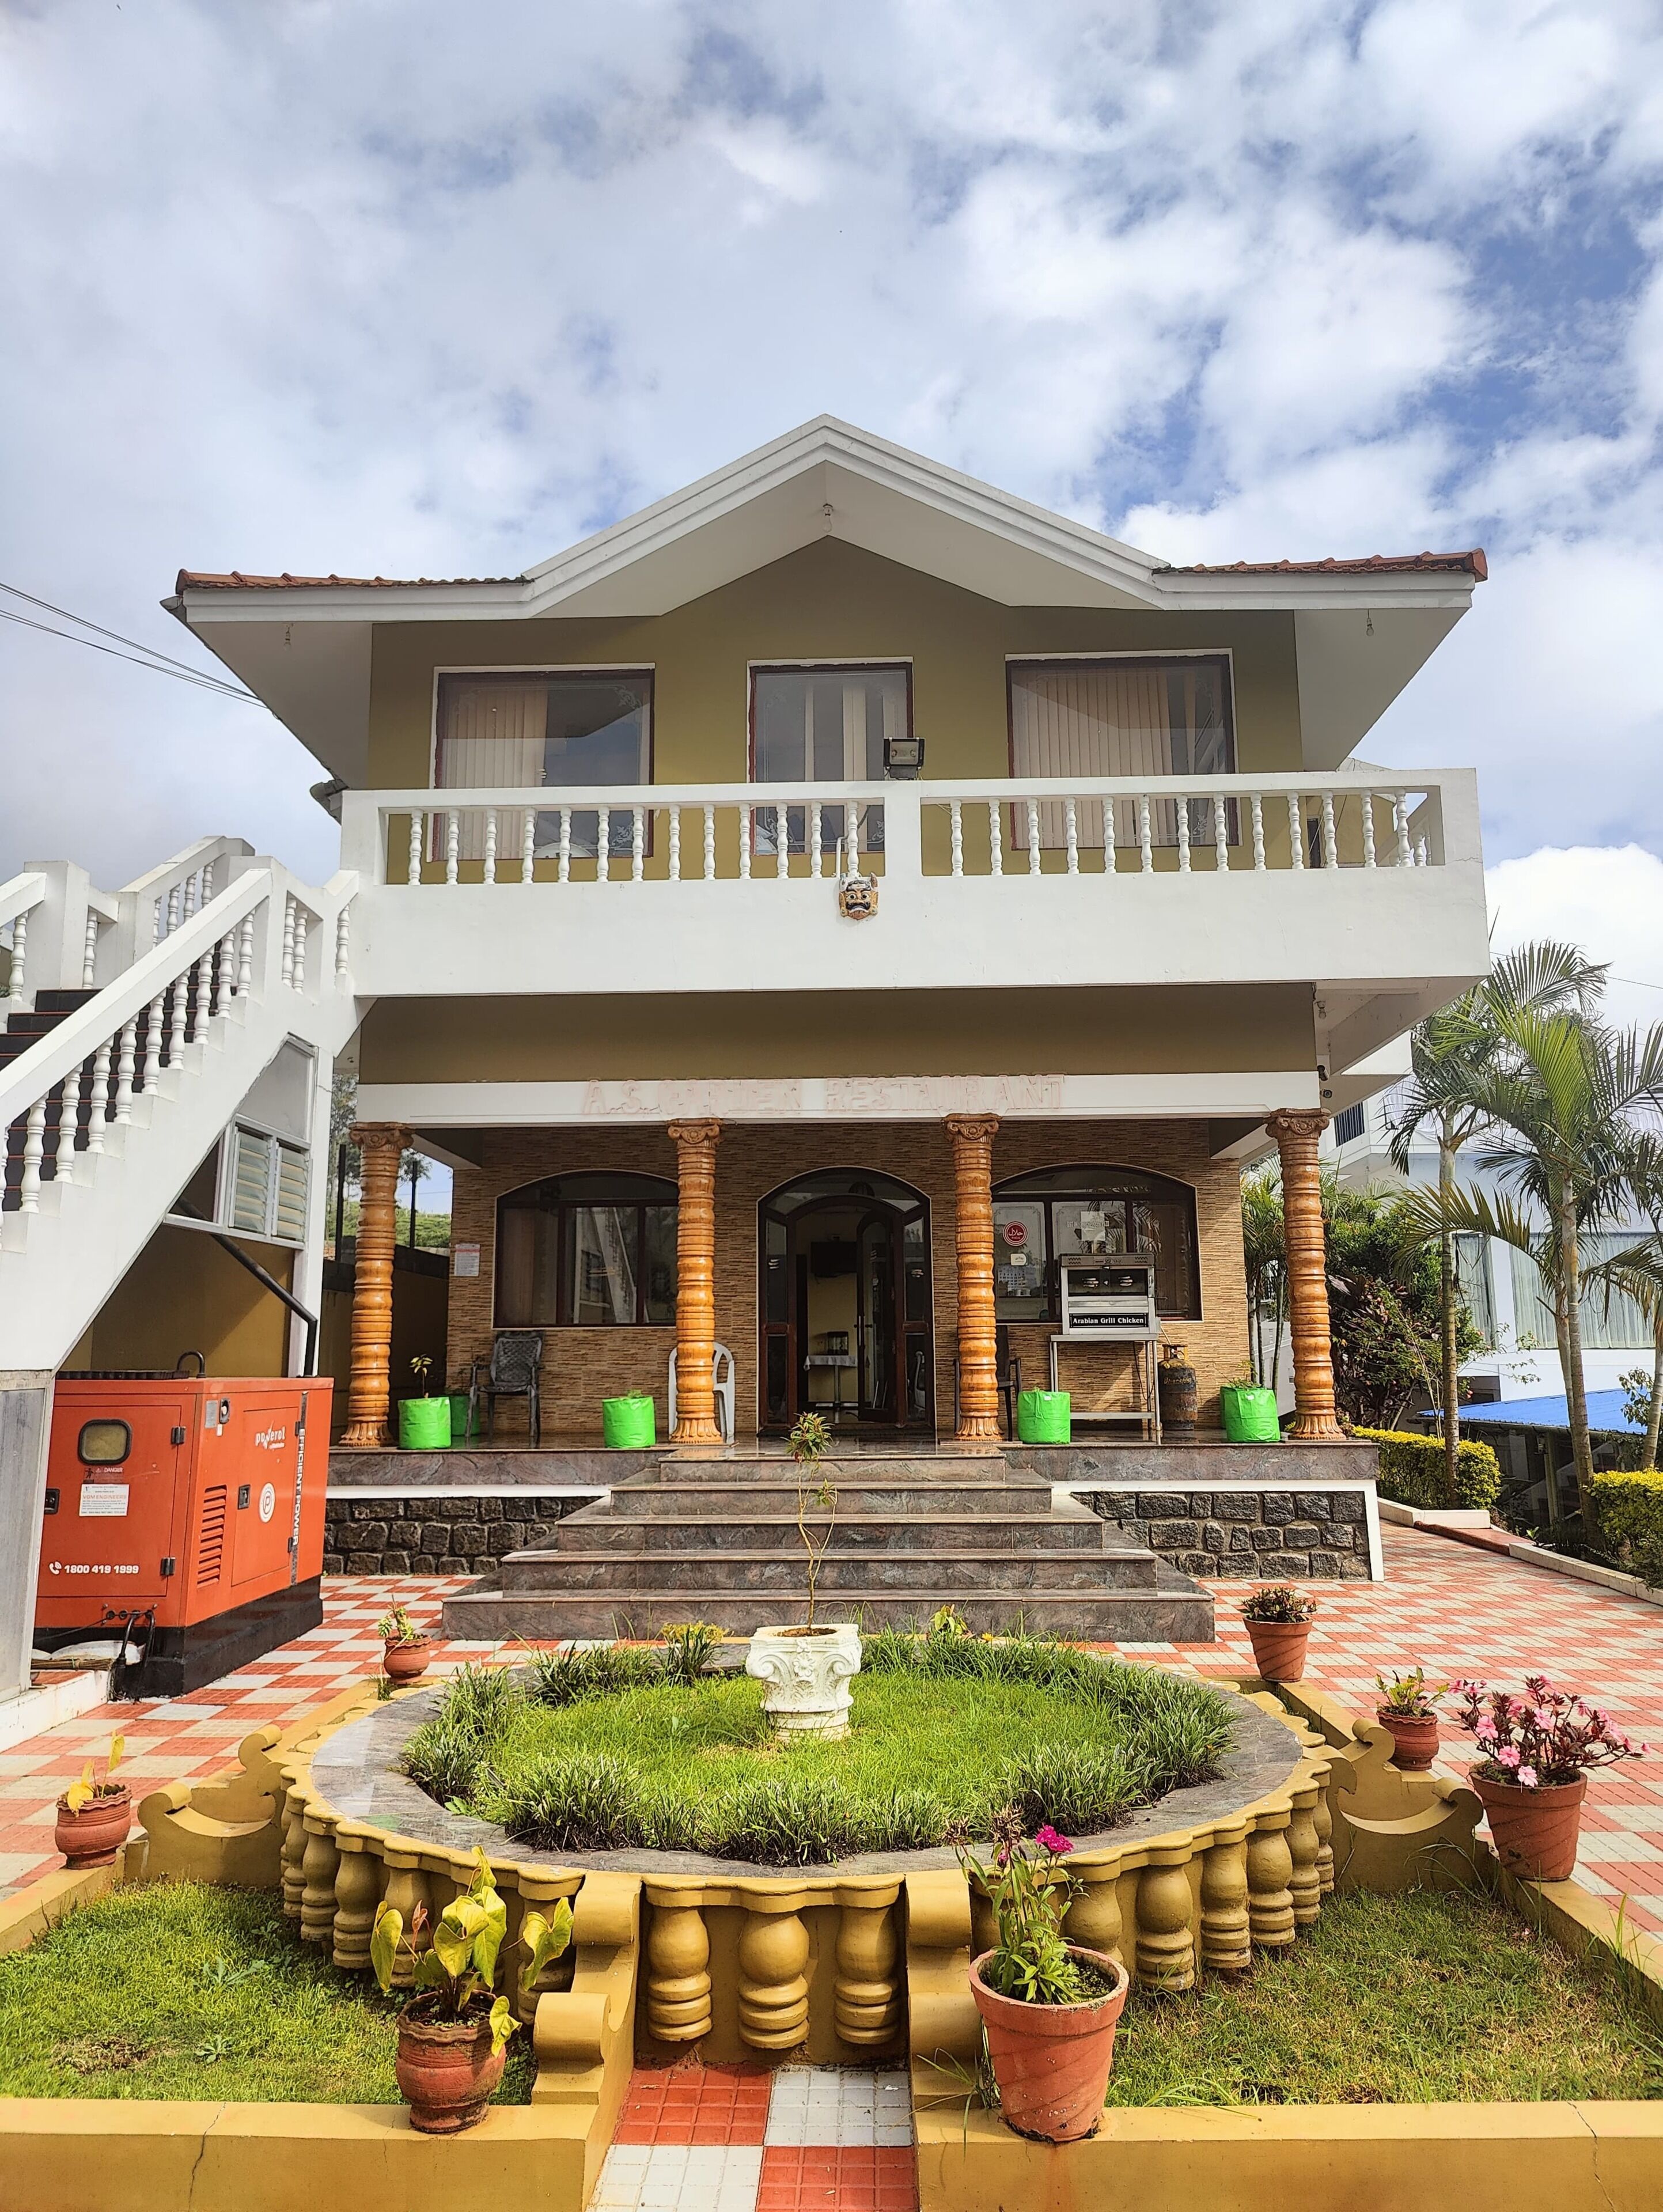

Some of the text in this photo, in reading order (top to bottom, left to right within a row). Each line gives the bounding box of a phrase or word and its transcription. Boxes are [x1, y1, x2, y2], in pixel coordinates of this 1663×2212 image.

[293, 1429, 305, 1546] EFFICIENT POWER
[64, 1565, 139, 1574] 1800 419 1999
